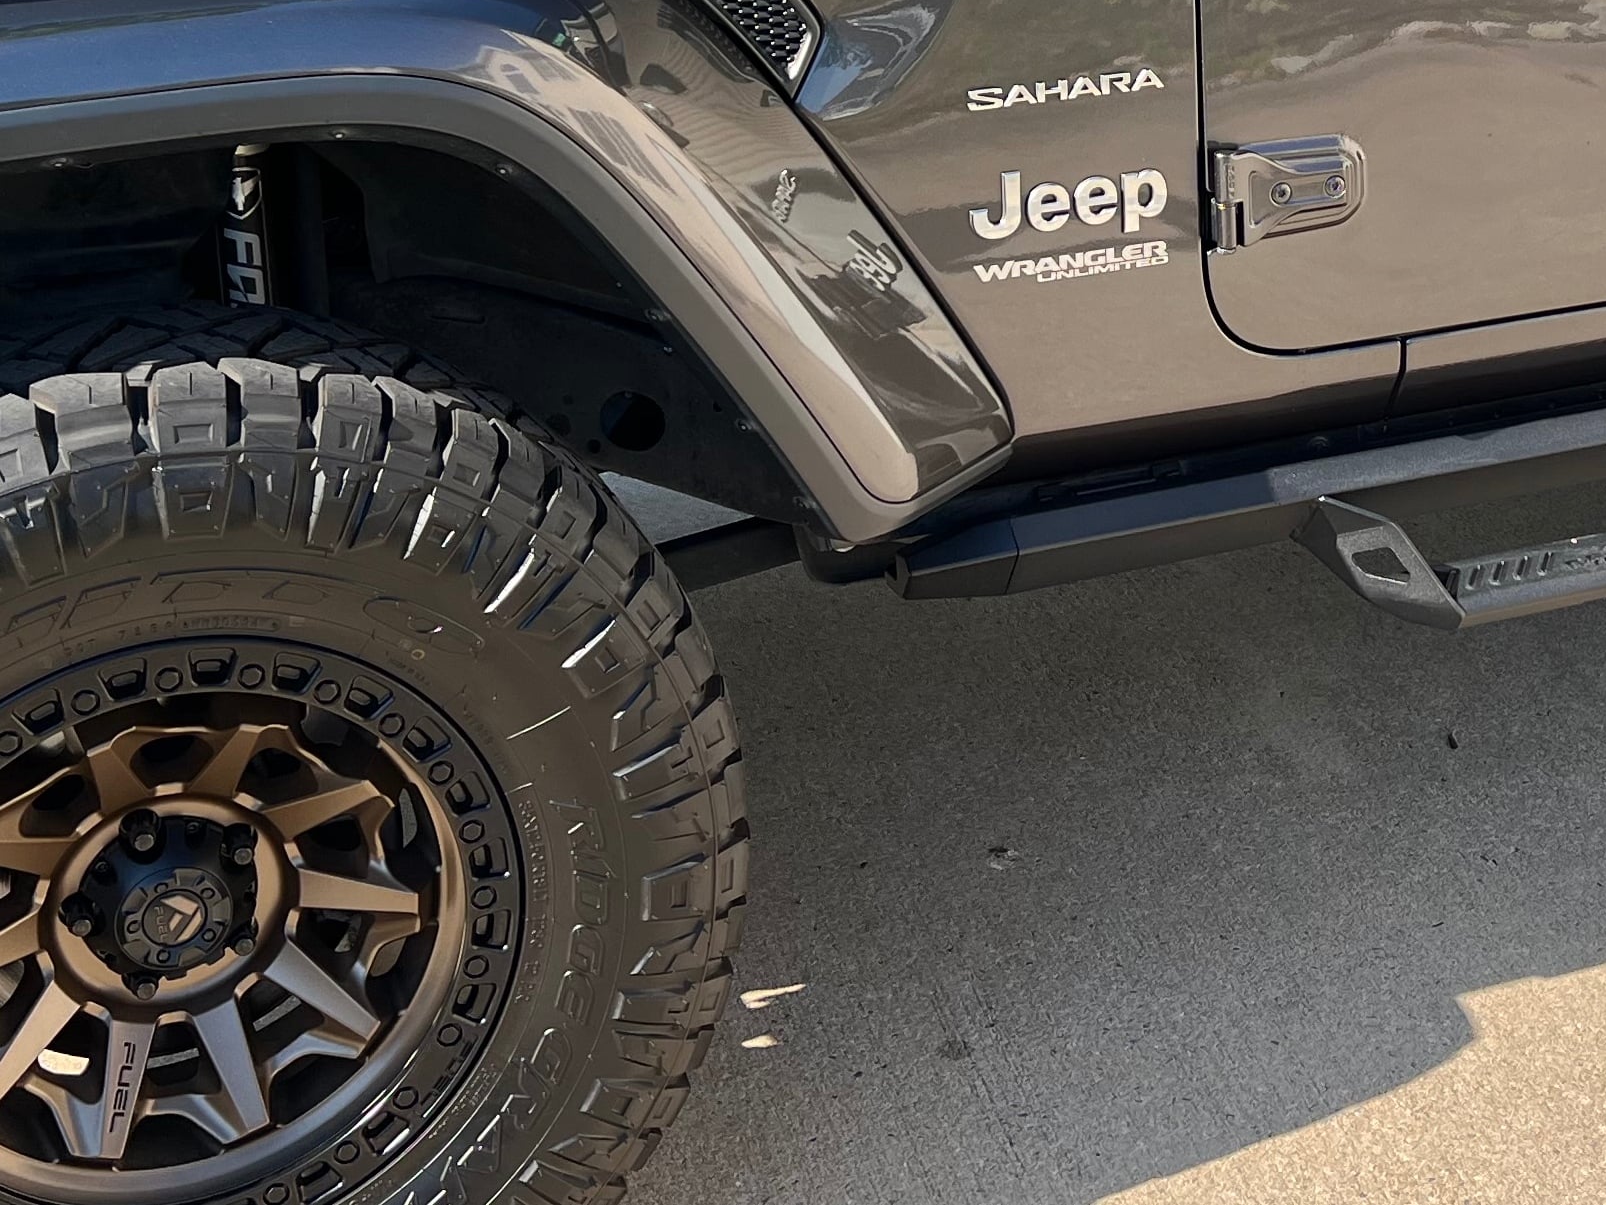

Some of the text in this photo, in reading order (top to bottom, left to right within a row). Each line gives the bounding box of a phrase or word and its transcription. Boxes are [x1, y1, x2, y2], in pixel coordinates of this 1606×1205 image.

[967, 69, 1165, 112] SAHARA
[968, 168, 1169, 240] Jeep
[973, 241, 1169, 283] WRANGLER
[1036, 255, 1169, 283] UNLIMITED
[153, 906, 169, 943] FUEL
[108, 1040, 137, 1134] FUEL
